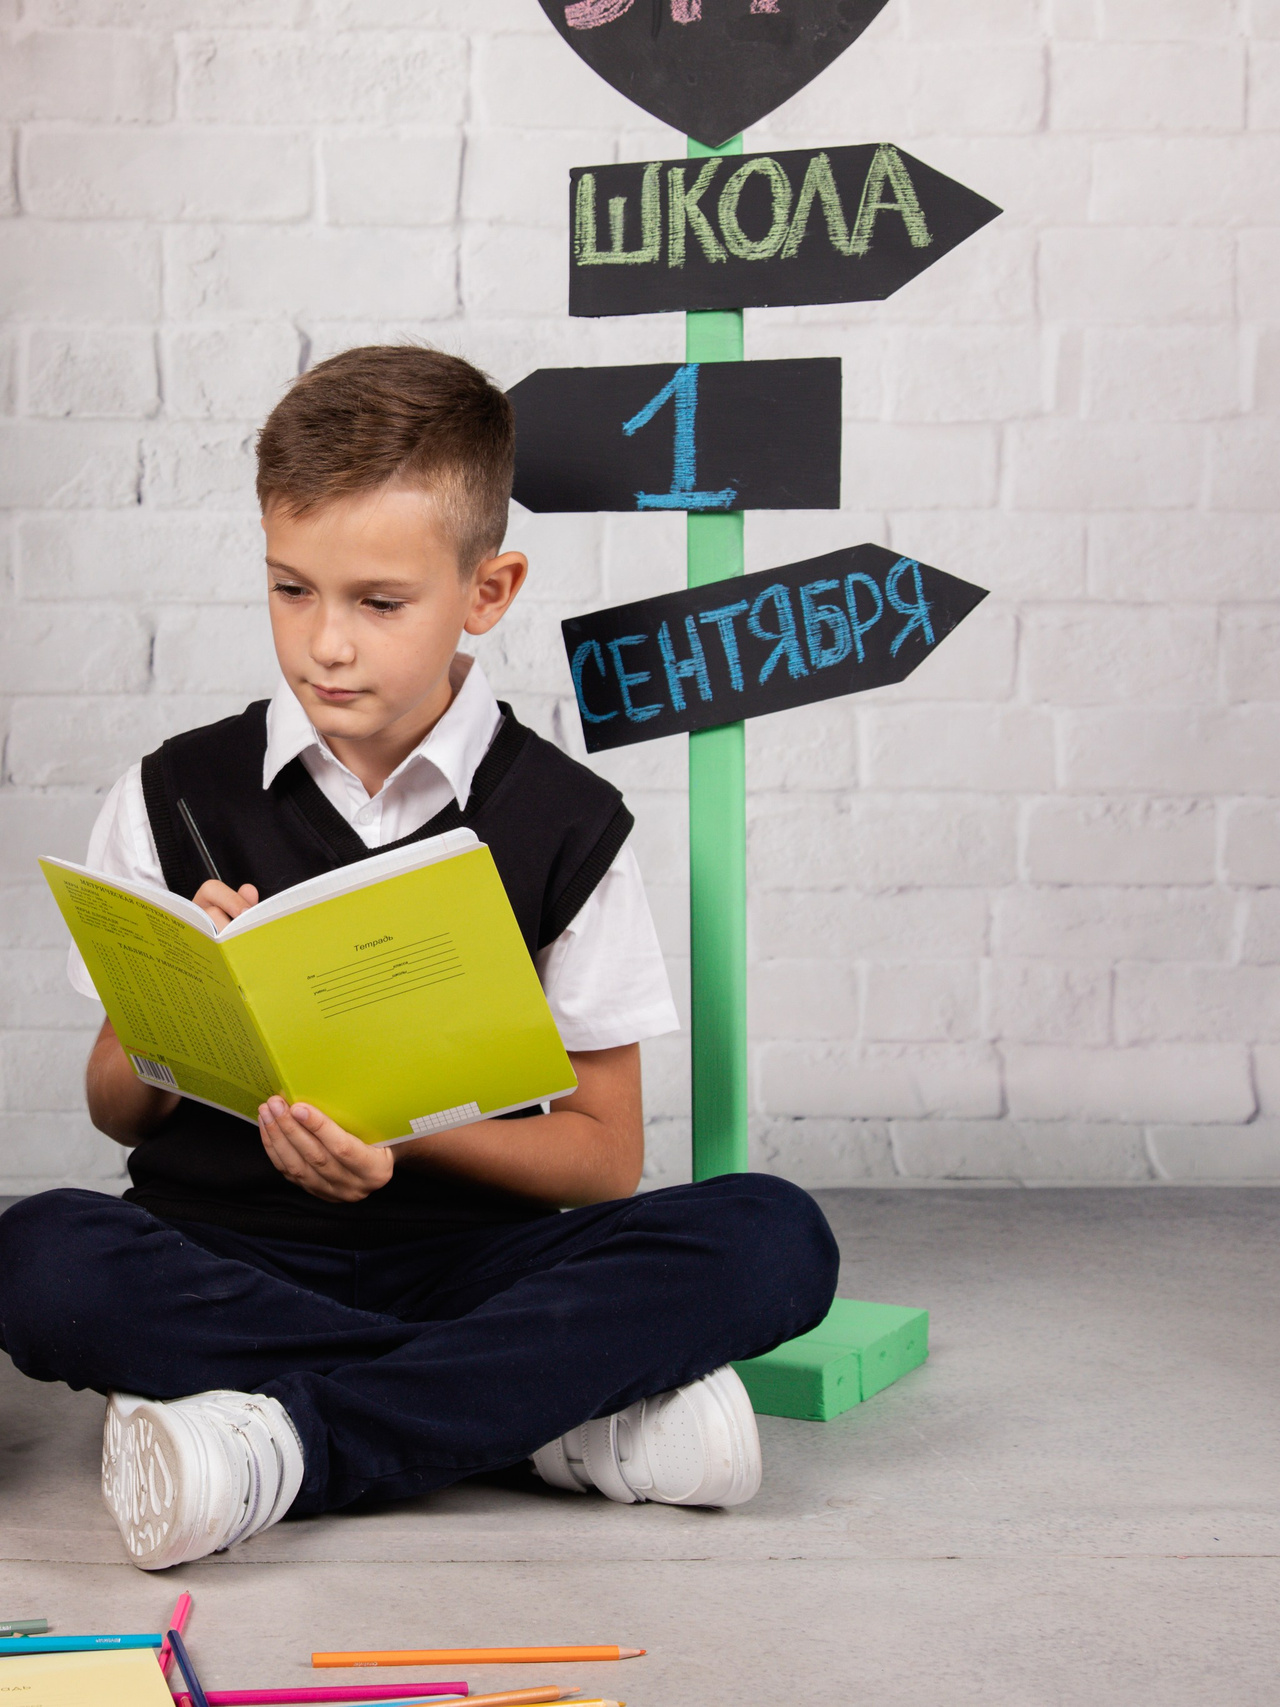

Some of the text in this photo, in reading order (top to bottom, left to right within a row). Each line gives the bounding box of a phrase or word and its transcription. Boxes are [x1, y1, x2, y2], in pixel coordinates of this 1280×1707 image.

[574, 142, 934, 268] ШКОЛА
[622, 362, 738, 511] 1
[571, 556, 935, 724] СЕНТЯБРЯ
[354, 934, 394, 952] Тетрадь
